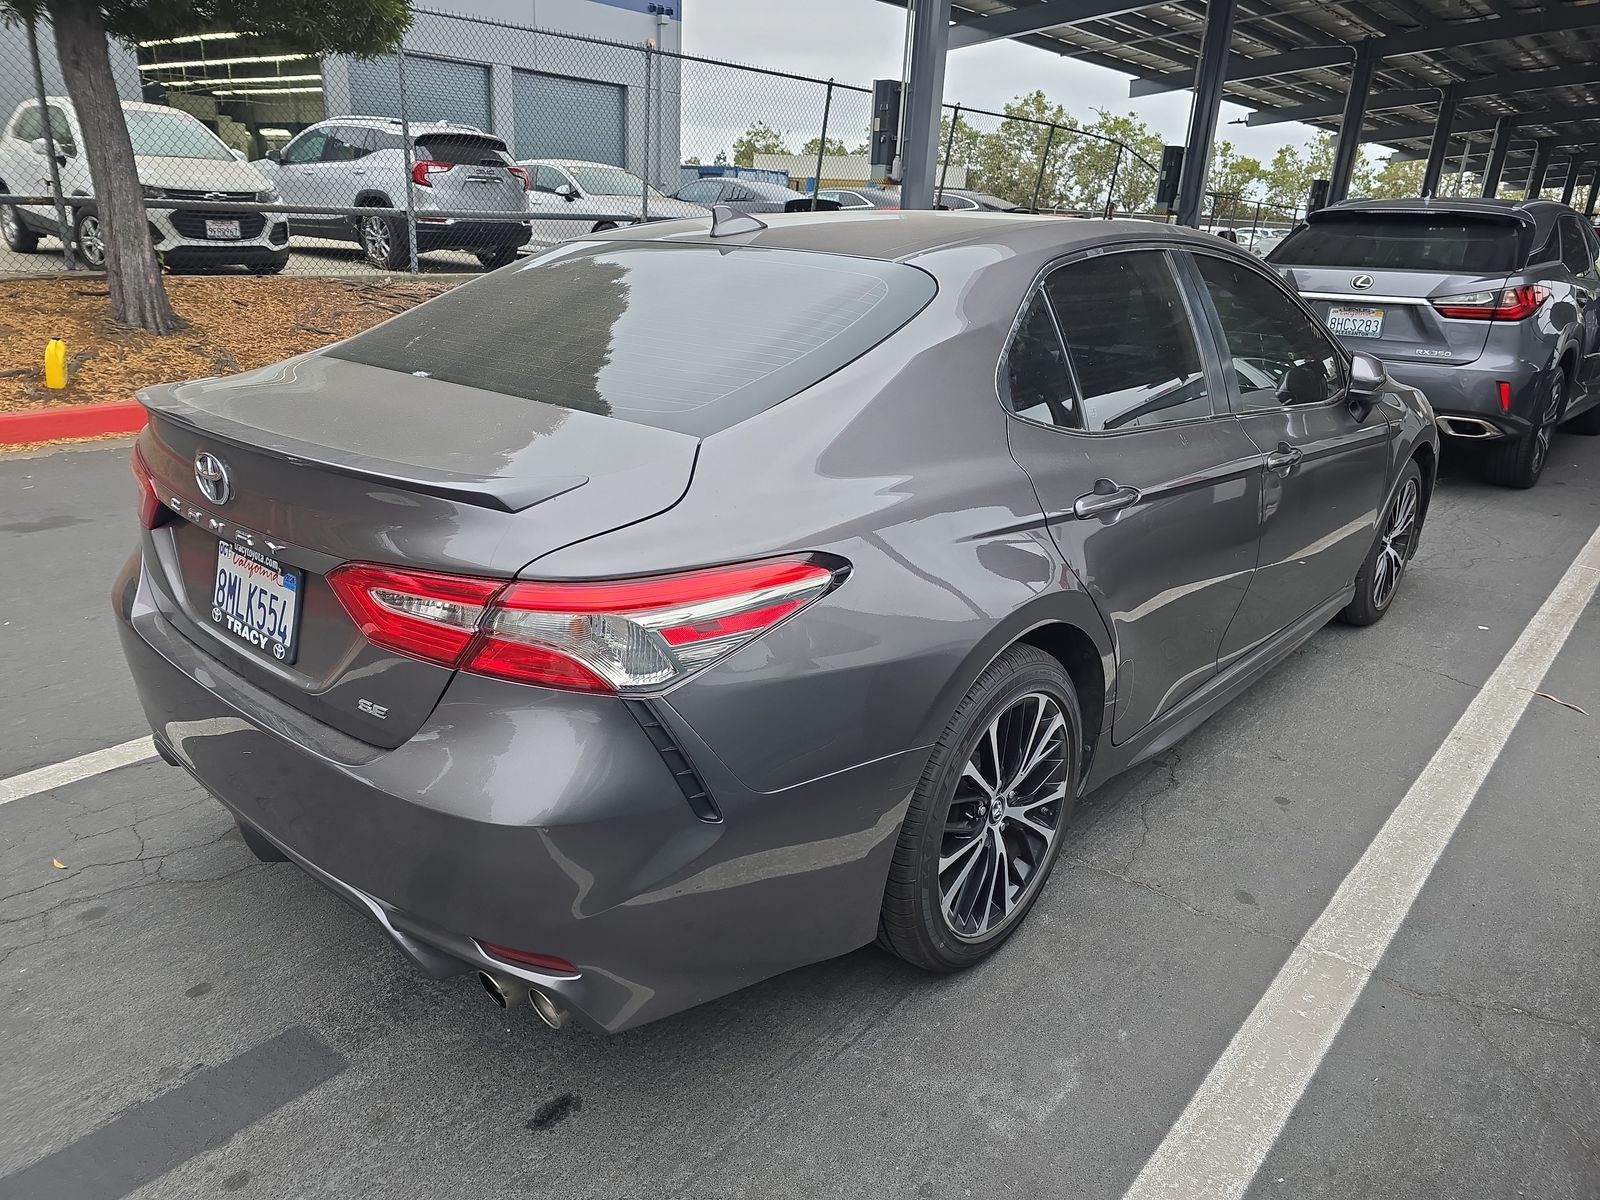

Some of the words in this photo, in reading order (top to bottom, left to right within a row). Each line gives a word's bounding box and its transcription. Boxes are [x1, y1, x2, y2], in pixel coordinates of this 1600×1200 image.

[1330, 317, 1380, 333] 8HCS283
[171, 497, 287, 555] CAMRY
[216, 568, 288, 645] 8MLK554
[226, 615, 269, 649] TRACY
[357, 698, 388, 720] SE
